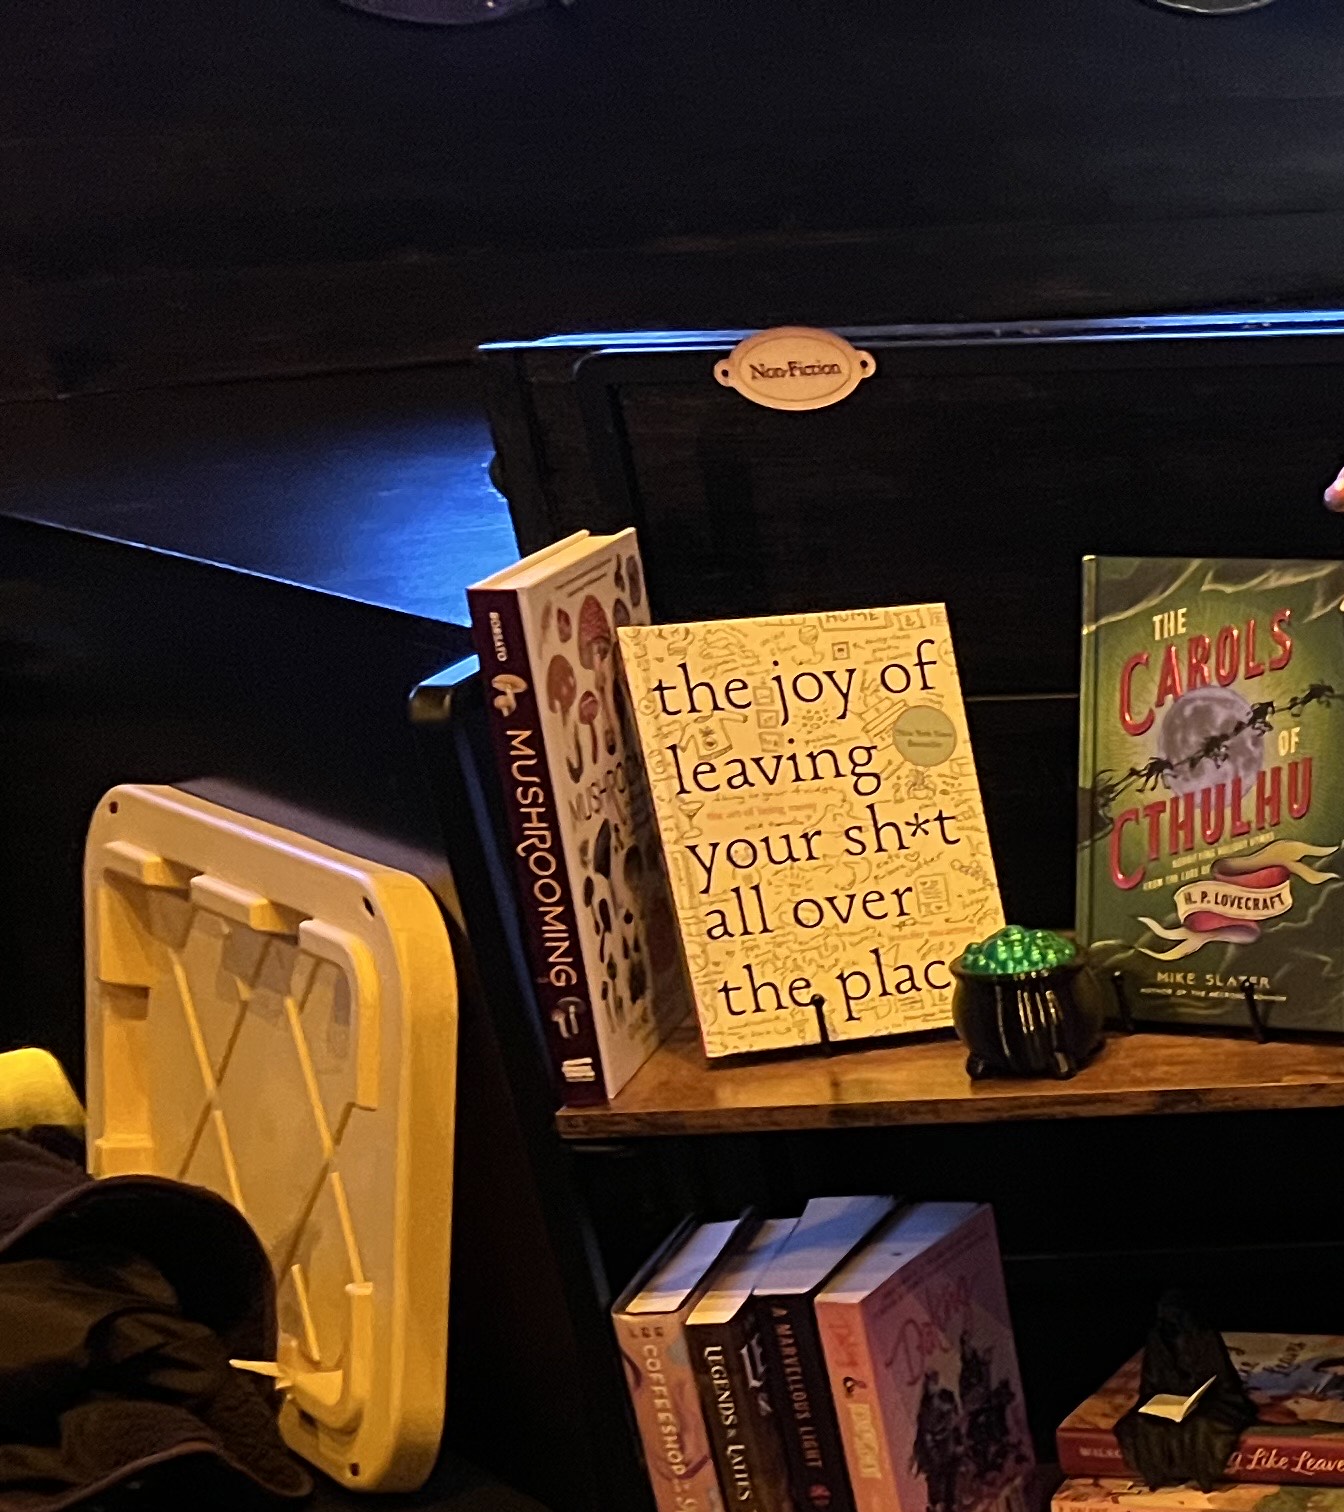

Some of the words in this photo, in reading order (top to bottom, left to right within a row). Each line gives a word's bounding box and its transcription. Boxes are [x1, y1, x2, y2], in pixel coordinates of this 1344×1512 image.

[749, 358, 842, 381] Non-Fiction
[1152, 608, 1188, 642] THE
[652, 664, 753, 718] the
[770, 659, 854, 726] joy
[880, 640, 938, 692] of
[1118, 606, 1294, 736] CAROLS
[1277, 722, 1301, 756] OF
[666, 742, 882, 798] leaving
[1107, 758, 1314, 890] CTHULHU
[506, 729, 576, 984] MUSHROOMING
[687, 830, 821, 892] your
[705, 882, 773, 941] all
[794, 888, 914, 931] over
[1184, 893, 1198, 905] H.
[1200, 891, 1211, 903] P.
[1214, 892, 1285, 911] LOVECRAFT
[717, 965, 813, 1019] the
[835, 948, 956, 1022] plac
[1156, 971, 1197, 986] MIKE
[1248, 1448, 1290, 1473] Like
